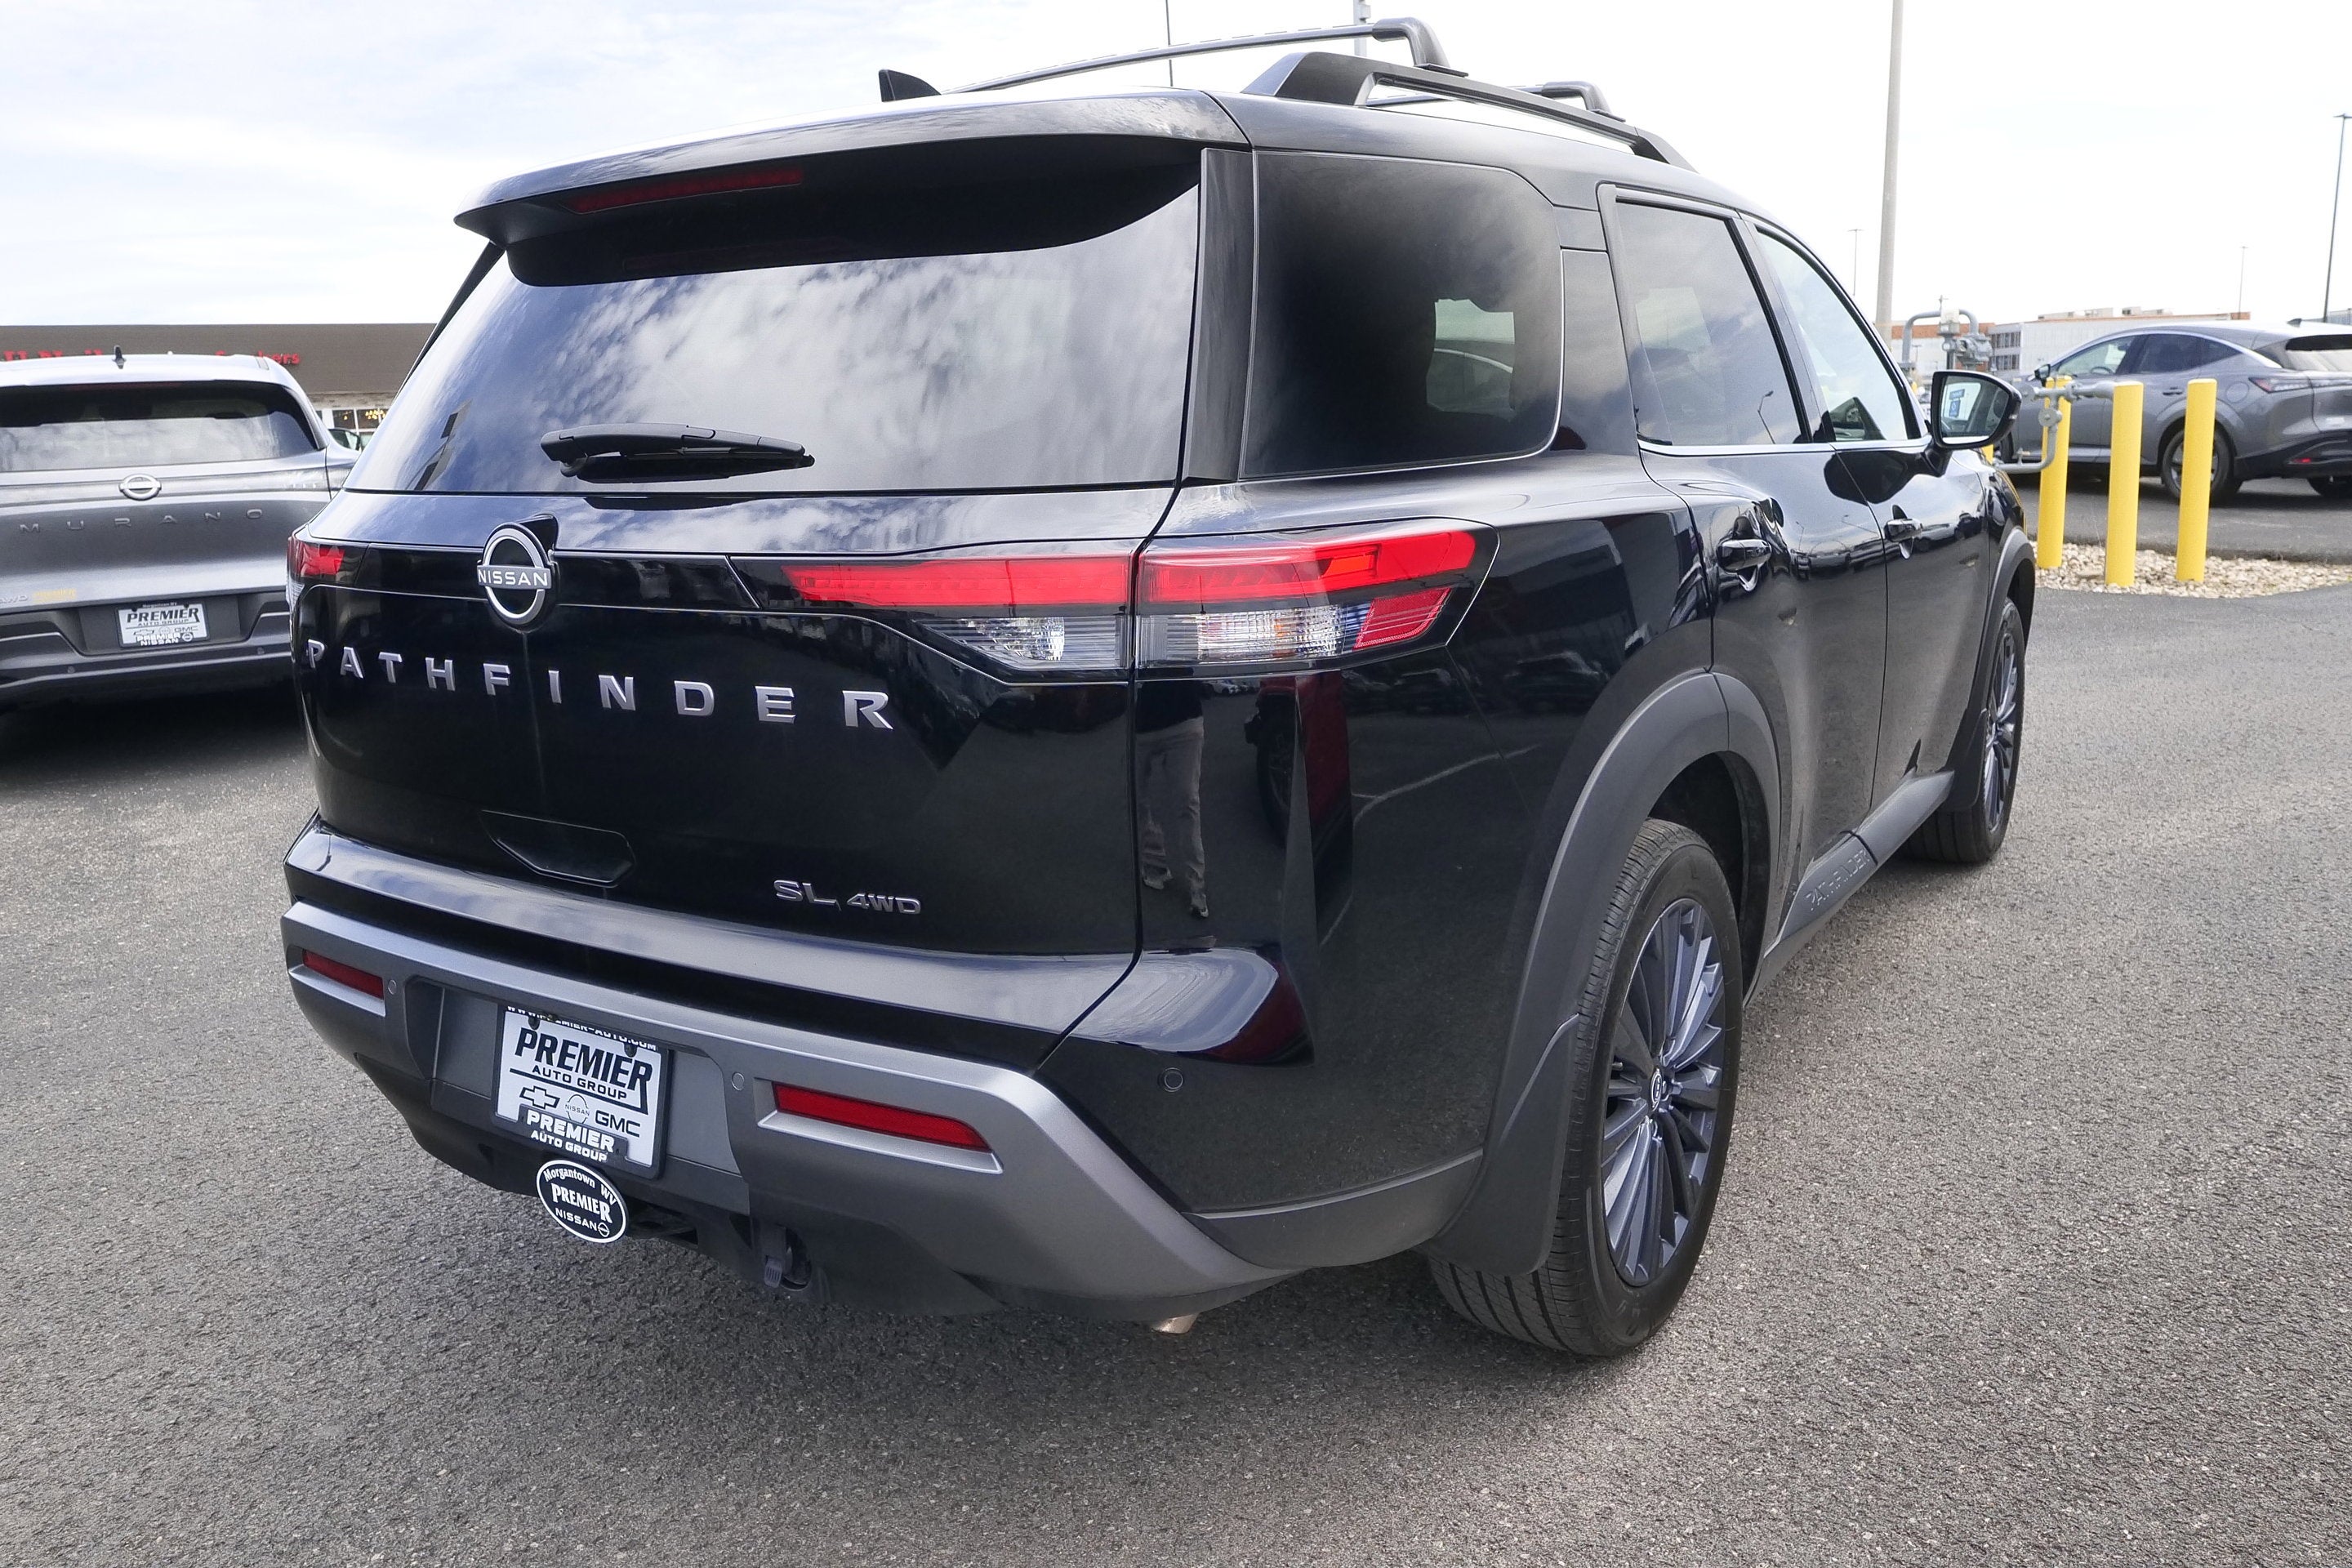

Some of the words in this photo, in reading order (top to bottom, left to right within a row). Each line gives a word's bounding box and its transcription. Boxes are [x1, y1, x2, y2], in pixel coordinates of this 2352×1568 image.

[20, 508, 263, 533] MURANO
[478, 569, 548, 586] NISSAN
[127, 608, 201, 623] PREMIER
[136, 632, 180, 642] PREMIER
[140, 638, 179, 647] NISSAN
[307, 639, 893, 729] PATHFINDER
[773, 880, 838, 905] SL
[846, 892, 921, 915] 4WD
[514, 1027, 653, 1116] PREMIER
[532, 1064, 572, 1083] AUTO
[577, 1076, 627, 1100] GROUP
[565, 1103, 590, 1117] NISSAN
[595, 1109, 641, 1138] GMC
[527, 1109, 614, 1153] PREMIER
[530, 1130, 563, 1148] AUTO
[564, 1142, 608, 1163] GROUP
[543, 1168, 595, 1189] Morgantown
[600, 1183, 617, 1205] WV
[550, 1183, 613, 1224] PREMIER
[555, 1207, 598, 1232] NISSAN
